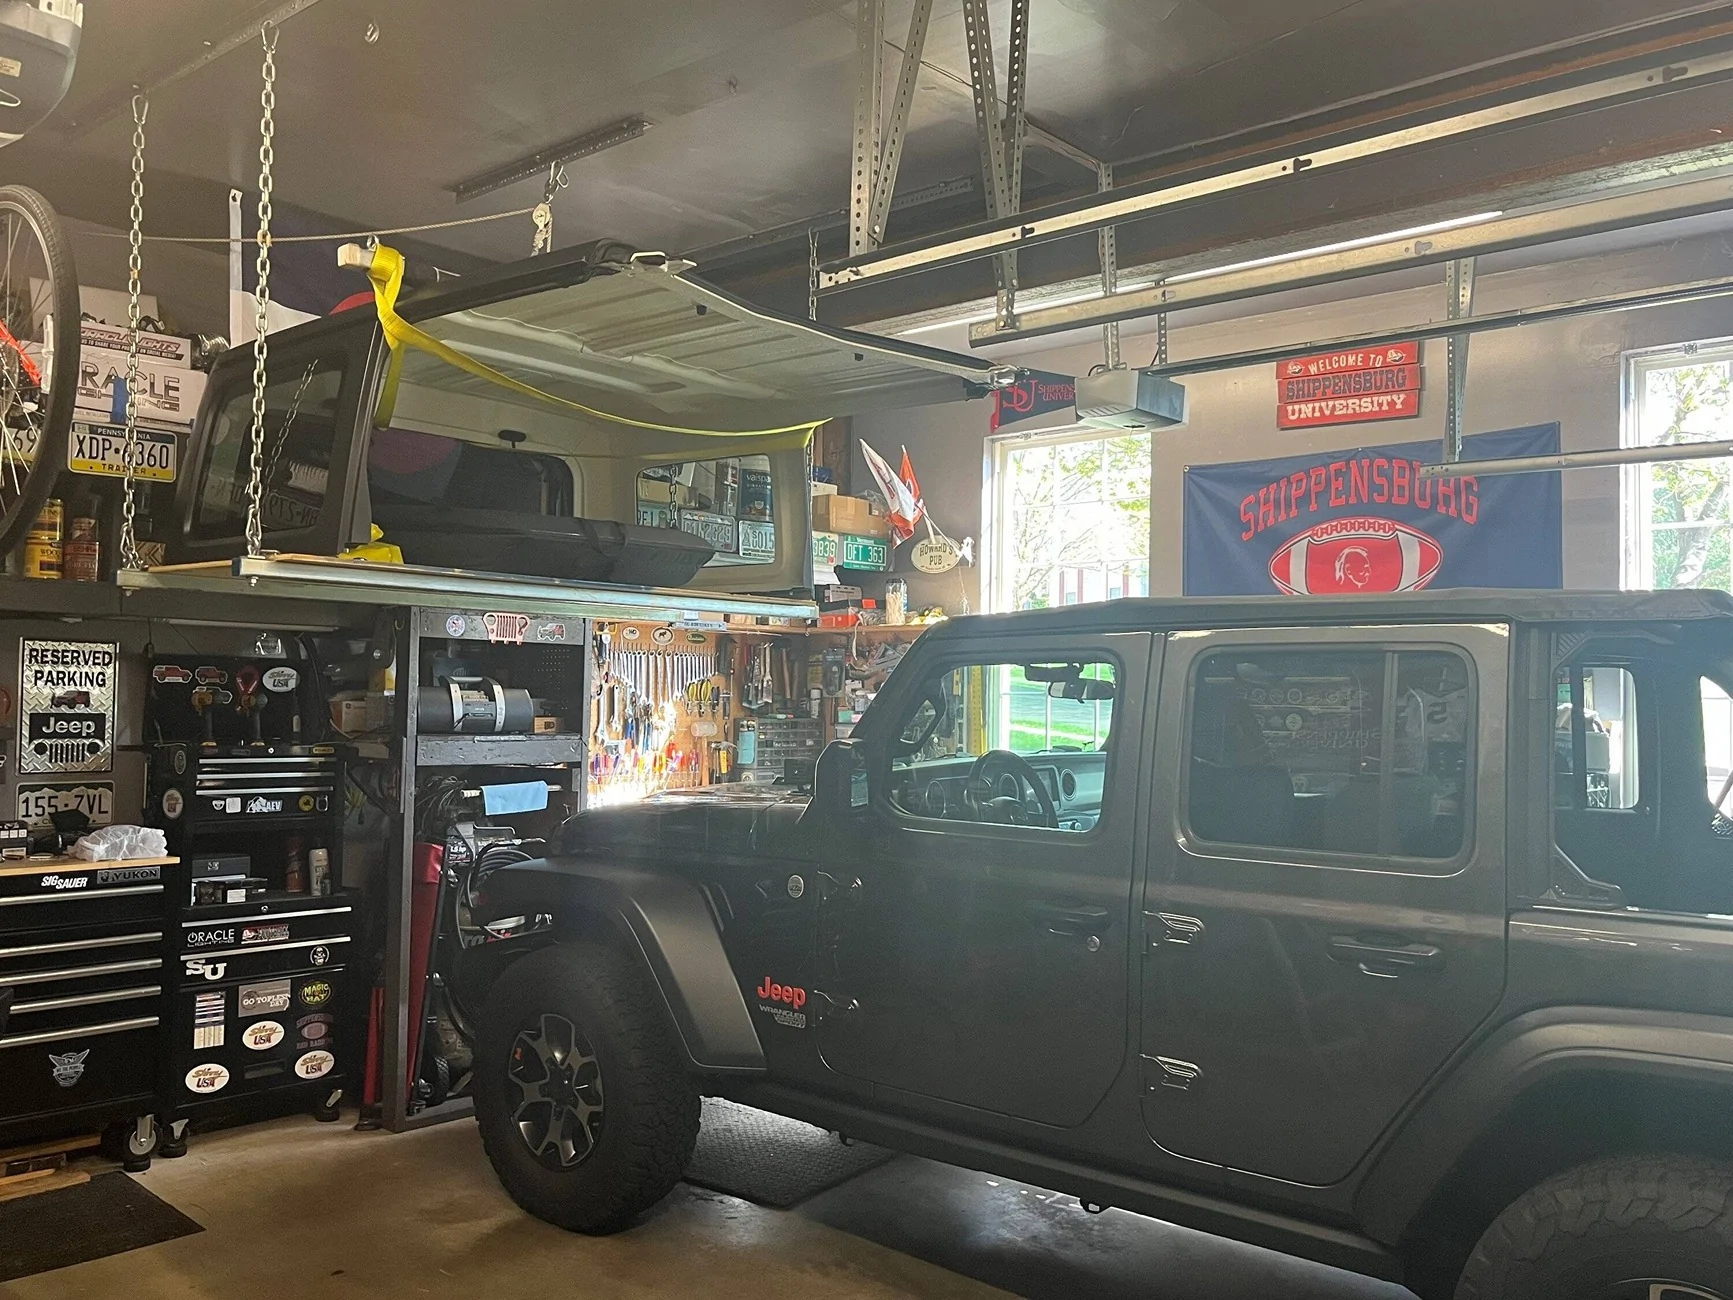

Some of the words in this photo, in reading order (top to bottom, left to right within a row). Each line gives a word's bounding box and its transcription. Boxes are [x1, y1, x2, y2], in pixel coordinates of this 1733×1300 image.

[147, 349, 162, 357] SOCIAL
[1308, 354, 1364, 375] WELCOME
[1369, 354, 1383, 367] TO
[81, 361, 180, 402] RACLE
[1286, 367, 1407, 400] SHIPPENSBURG
[1038, 384, 1075, 394] SHIPPENS
[1042, 392, 1074, 401] UNIVER
[1287, 394, 1406, 420] UNIVERSITY
[97, 428, 151, 440] PENNSYVNIA
[102, 463, 146, 474] TRAIER
[868, 547, 883, 563] 363
[929, 555, 943, 565] PUB
[28, 648, 113, 666] RESERVED
[34, 670, 107, 688] PARKING
[42, 717, 96, 736] Jeep
[41, 875, 59, 887] SIG
[56, 877, 89, 889] SAUER
[112, 870, 158, 882] YUKON
[187, 929, 235, 943] ORACLE
[186, 959, 227, 980] SU
[304, 983, 329, 996] MAGIC
[757, 976, 806, 1010] Jeep
[243, 998, 256, 1006] GO
[269, 1000, 284, 1008] DAY
[759, 1004, 806, 1020] WRANGLER
